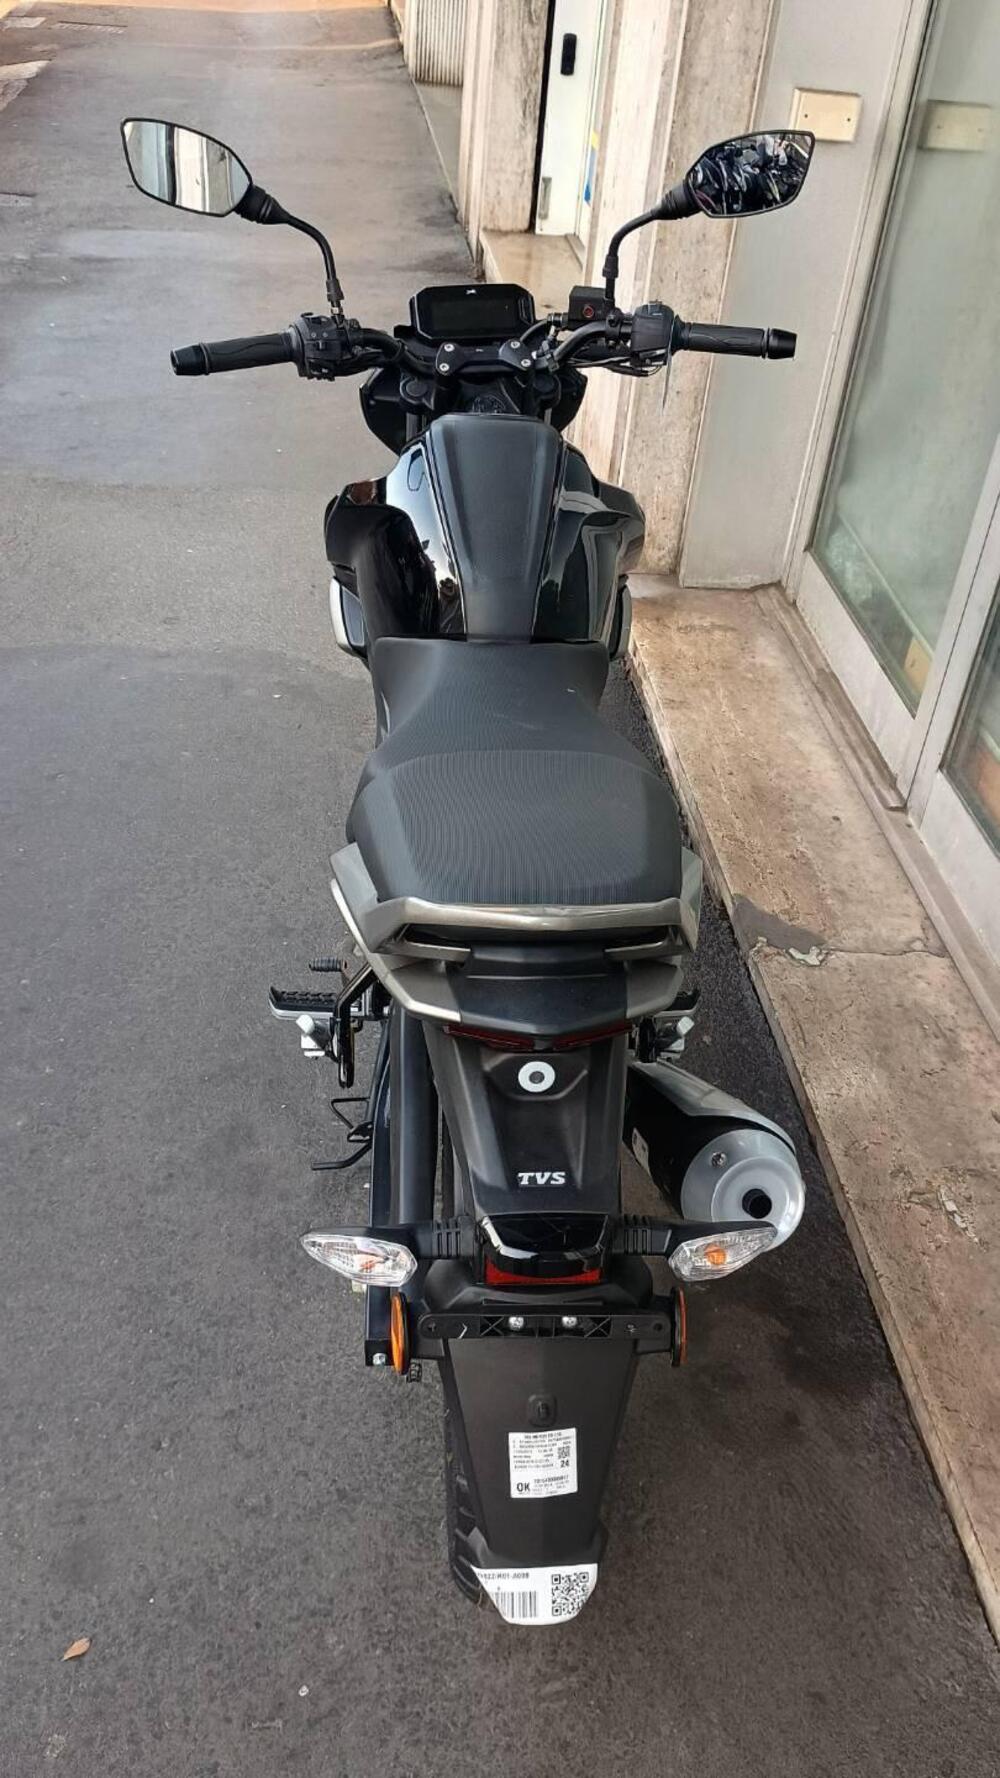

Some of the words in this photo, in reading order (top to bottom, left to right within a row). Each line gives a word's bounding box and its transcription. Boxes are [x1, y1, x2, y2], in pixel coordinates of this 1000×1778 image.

[518, 1172, 566, 1185] TVS
[560, 1459, 569, 1468] 24
[516, 1482, 530, 1493] OK
